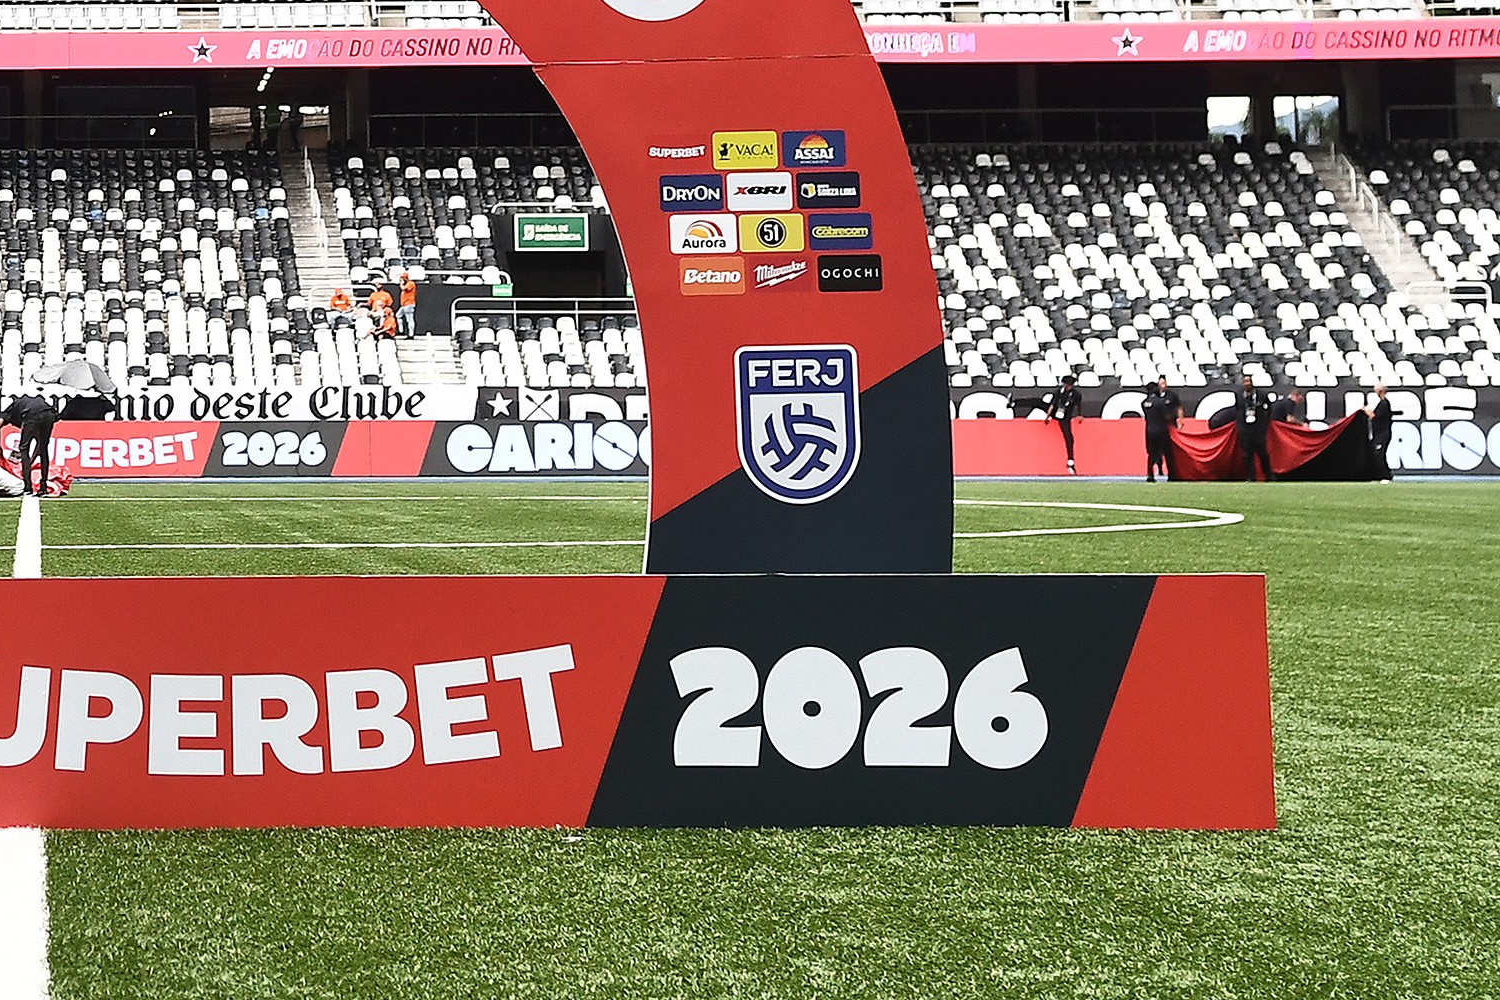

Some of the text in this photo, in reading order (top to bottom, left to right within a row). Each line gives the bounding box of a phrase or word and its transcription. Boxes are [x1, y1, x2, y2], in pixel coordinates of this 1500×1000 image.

[246, 39, 261, 60] A
[349, 39, 374, 57] DO
[380, 37, 461, 57] CASSINO
[466, 37, 492, 57] NO
[866, 32, 944, 57] ONHEÇA
[1183, 30, 1199, 52] A
[1291, 31, 1316, 49] DO
[1324, 29, 1407, 48] CASSINO
[1414, 29, 1441, 48] NO
[649, 145, 706, 158] SUPERBET
[735, 143, 774, 156] VACA!
[733, 185, 787, 196] XBRI
[682, 238, 727, 249] Aurora
[763, 224, 780, 242] 51
[684, 268, 741, 284] Betano
[821, 267, 879, 279] OGOCHI
[747, 358, 844, 387] FERJ
[189, 386, 293, 421] deste
[308, 385, 427, 421] Clube
[221, 430, 328, 467] 2026
[446, 421, 647, 473] CARIO
[669, 645, 1050, 770] 2026
